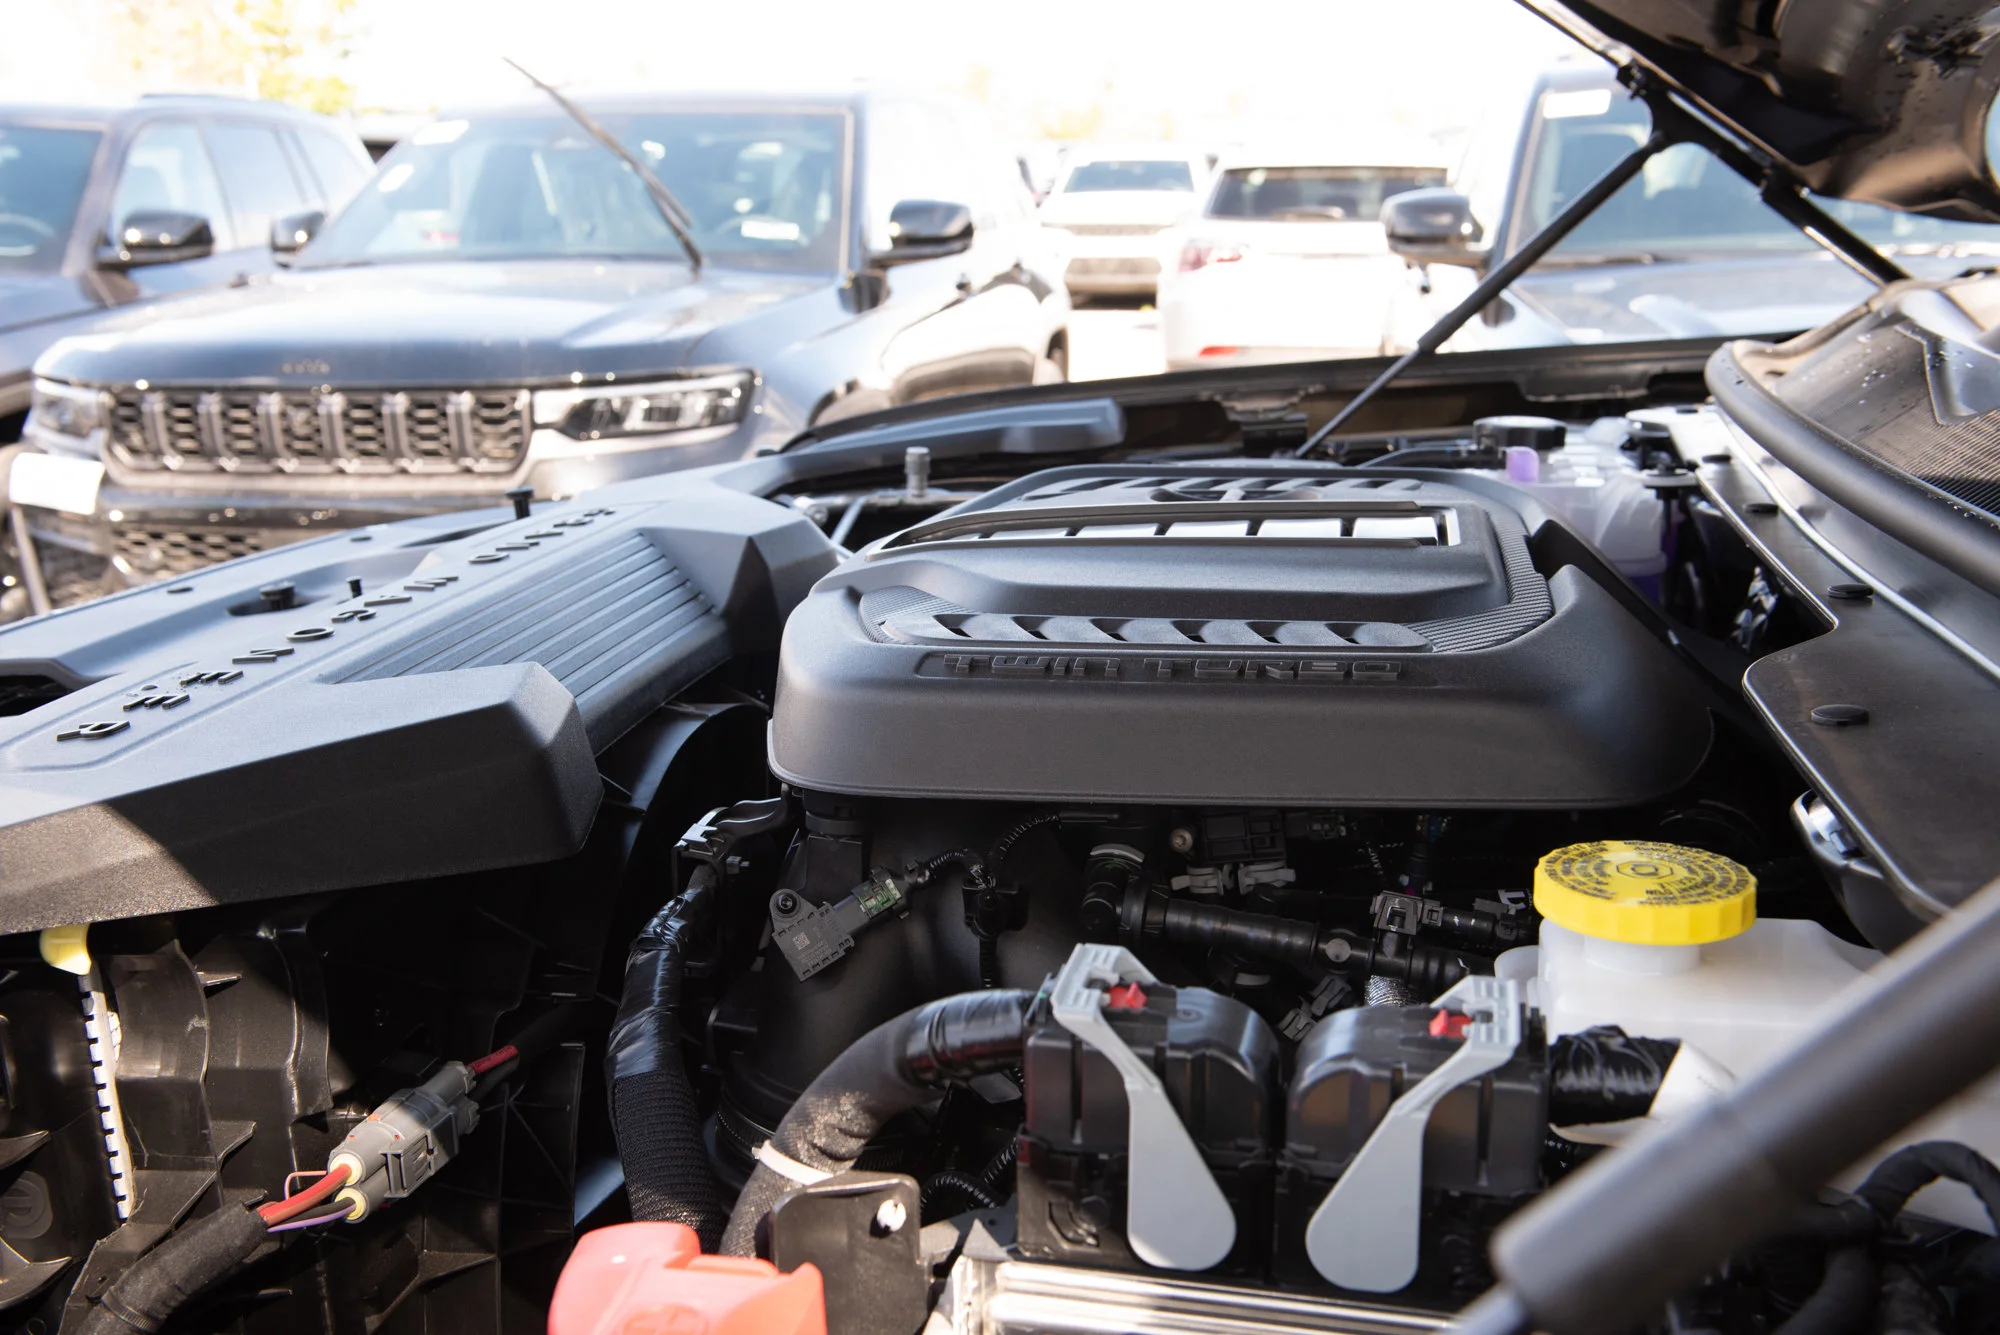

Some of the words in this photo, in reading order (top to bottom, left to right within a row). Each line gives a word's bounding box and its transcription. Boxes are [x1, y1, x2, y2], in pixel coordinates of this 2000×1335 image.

[56, 575, 459, 742] WAGONEER
[944, 653, 1121, 677] TWIN
[1143, 657, 1401, 681] TURBO
